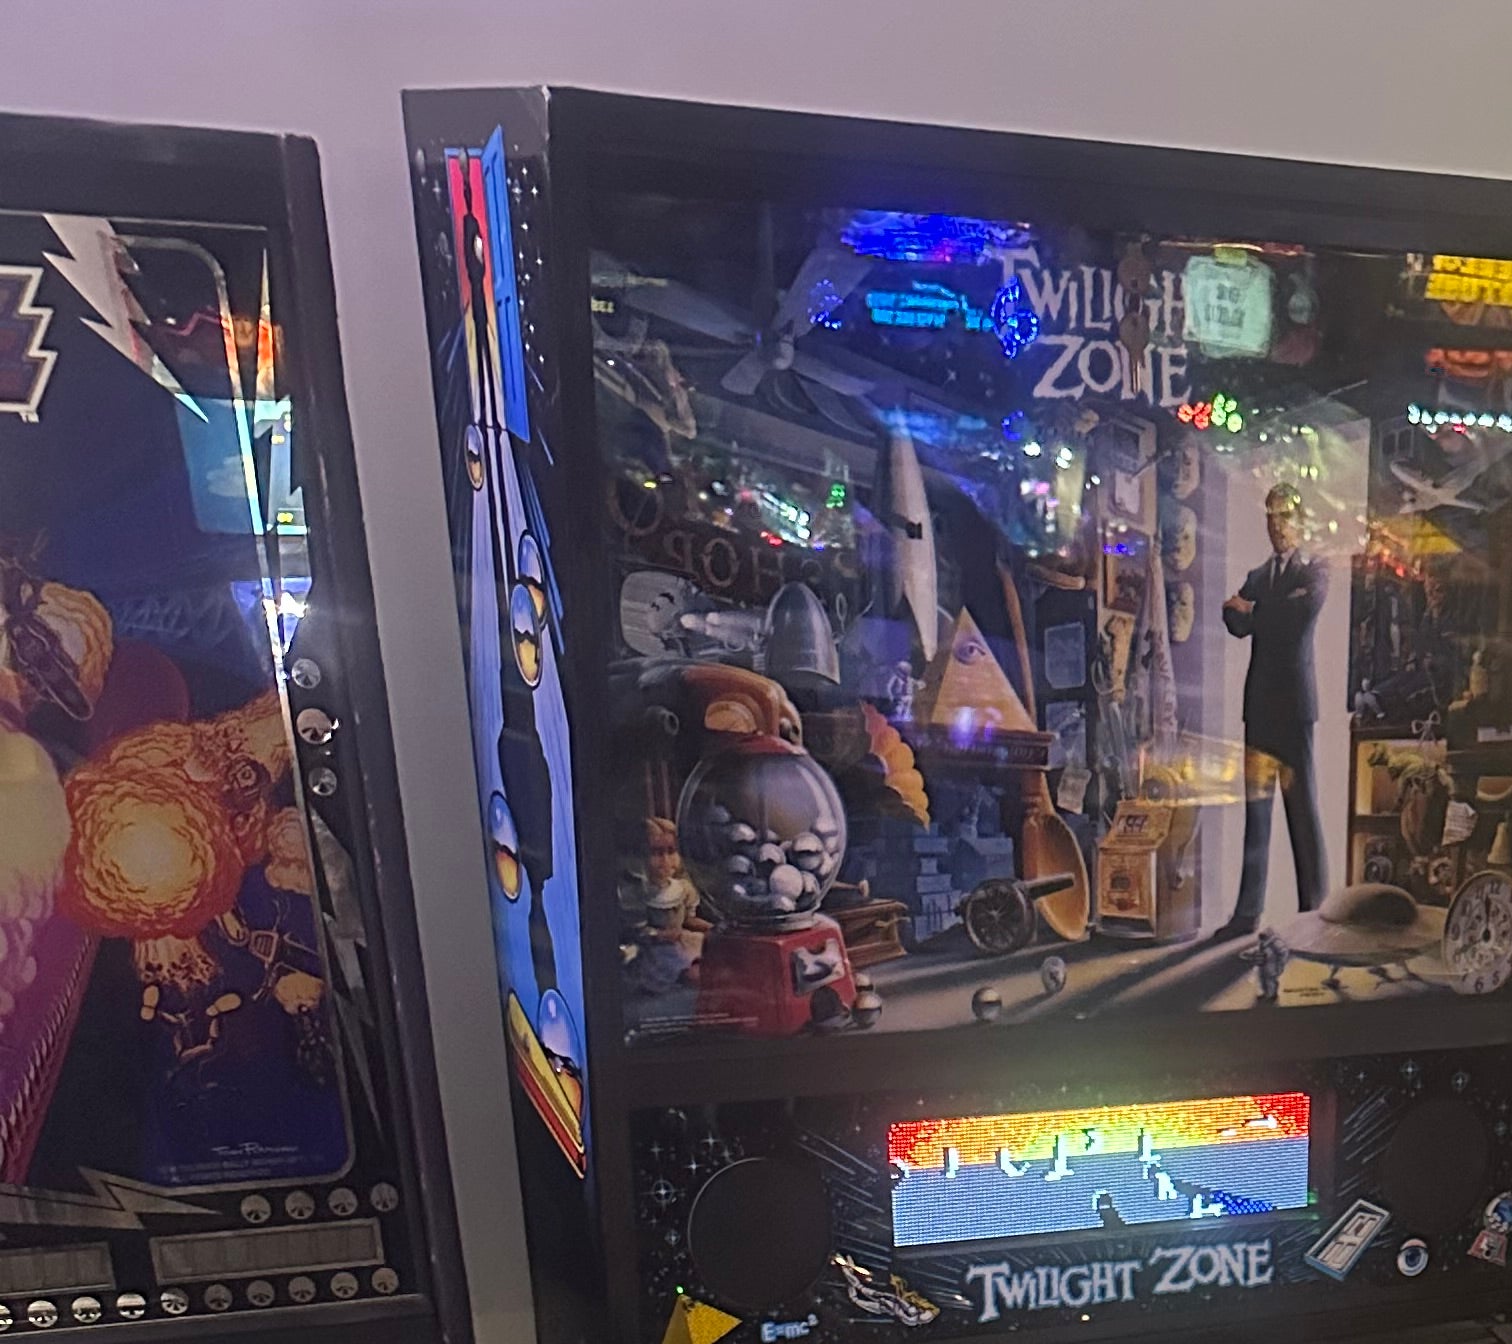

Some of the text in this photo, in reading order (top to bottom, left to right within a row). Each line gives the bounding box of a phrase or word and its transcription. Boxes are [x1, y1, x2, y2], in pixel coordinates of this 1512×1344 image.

[1032, 333, 1192, 408] ZONE
[966, 1240, 1274, 1322] TWILIGHT ZONE
